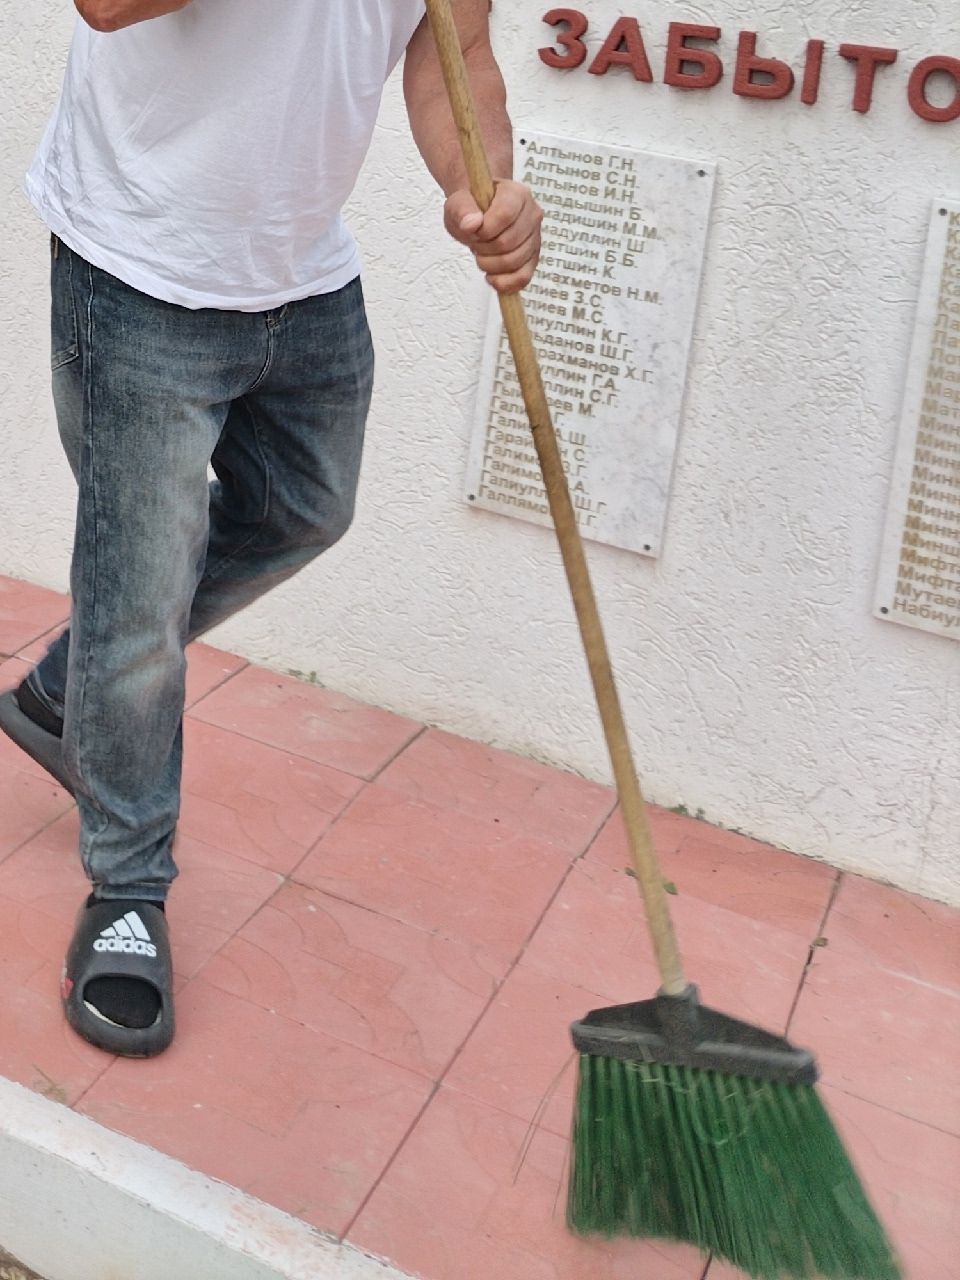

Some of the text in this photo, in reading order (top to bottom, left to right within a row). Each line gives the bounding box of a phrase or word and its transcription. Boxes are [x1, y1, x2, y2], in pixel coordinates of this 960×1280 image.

[538, 8, 960, 123] ЗАБЫТО
[526, 141, 603, 166] Алтынов
[524, 156, 601, 181] Алтынов
[522, 171, 599, 196] Алтынов
[531, 190, 624, 217] хмадышин
[541, 209, 618, 232] мадишин
[478, 484, 548, 515] Галлямо
[92, 936, 158, 958] adidas
